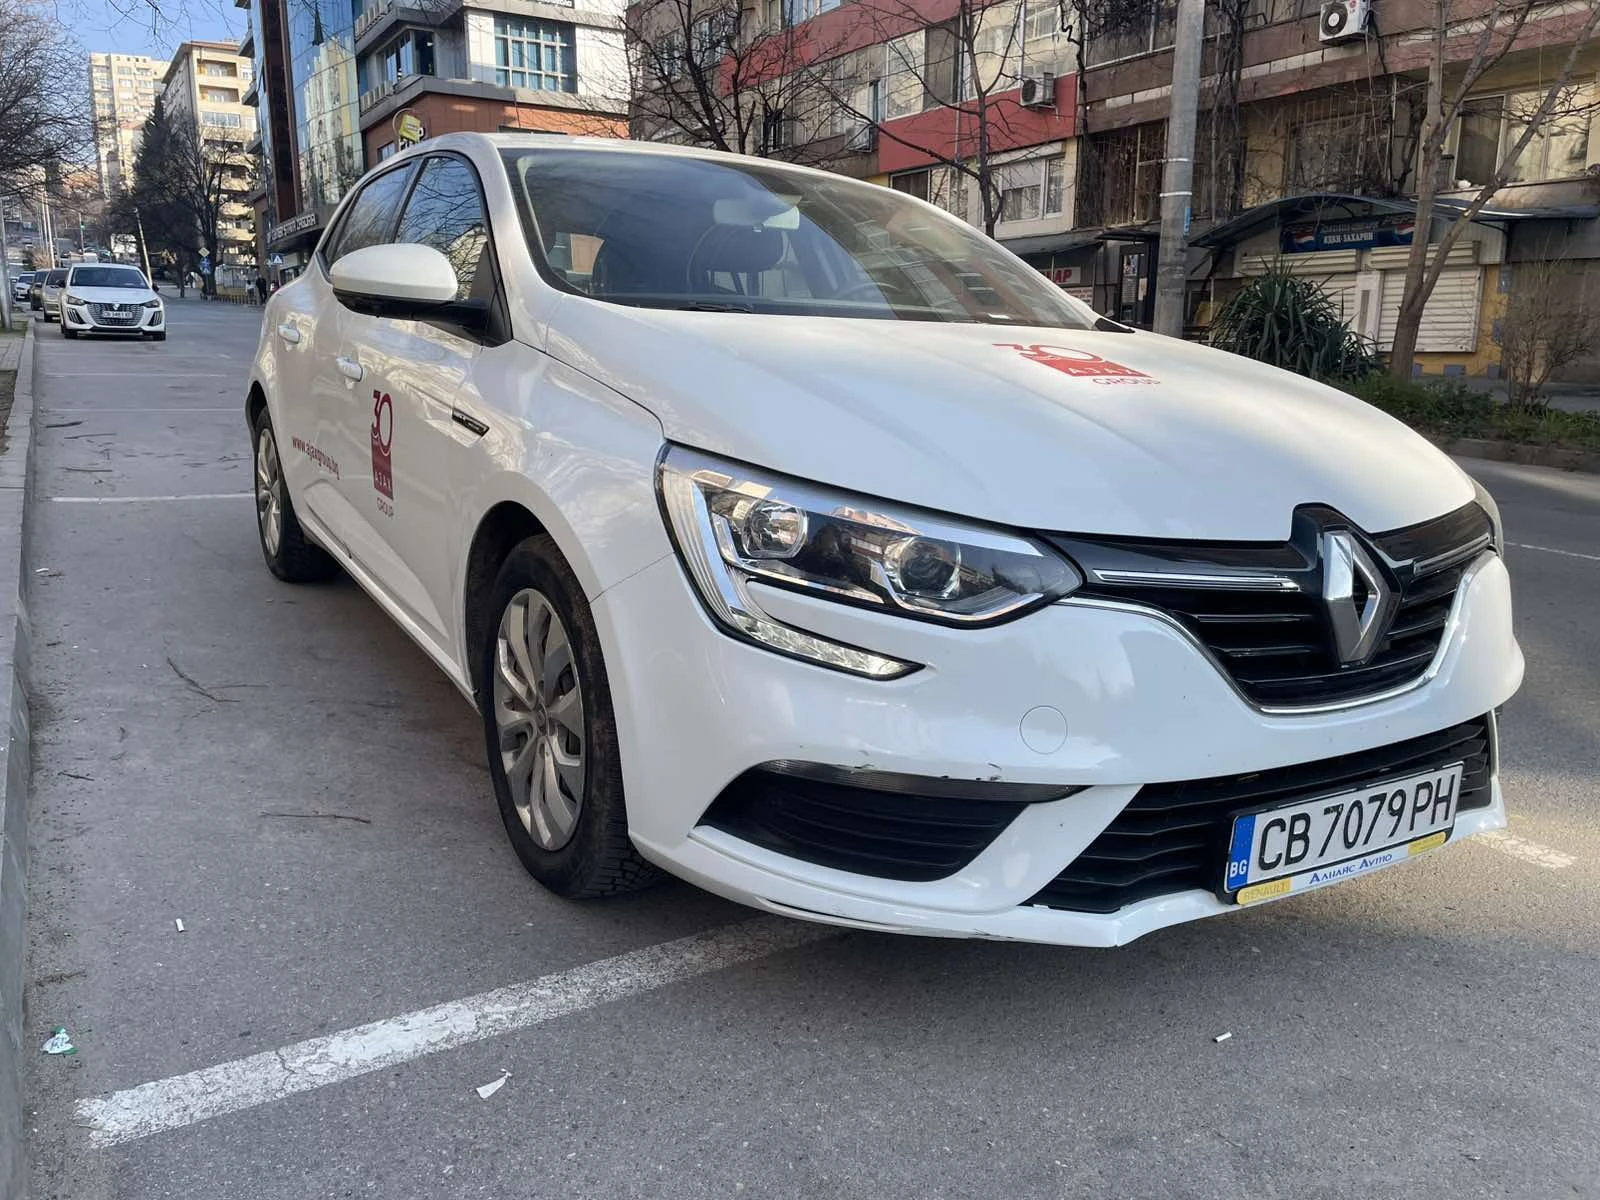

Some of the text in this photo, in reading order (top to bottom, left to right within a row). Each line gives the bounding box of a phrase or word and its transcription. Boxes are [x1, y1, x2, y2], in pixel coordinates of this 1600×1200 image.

[1092, 377, 1161, 386] GROUP
[372, 389, 393, 454] 30
[1258, 774, 1456, 871] CB 7079 PH
[1229, 860, 1248, 878] BG
